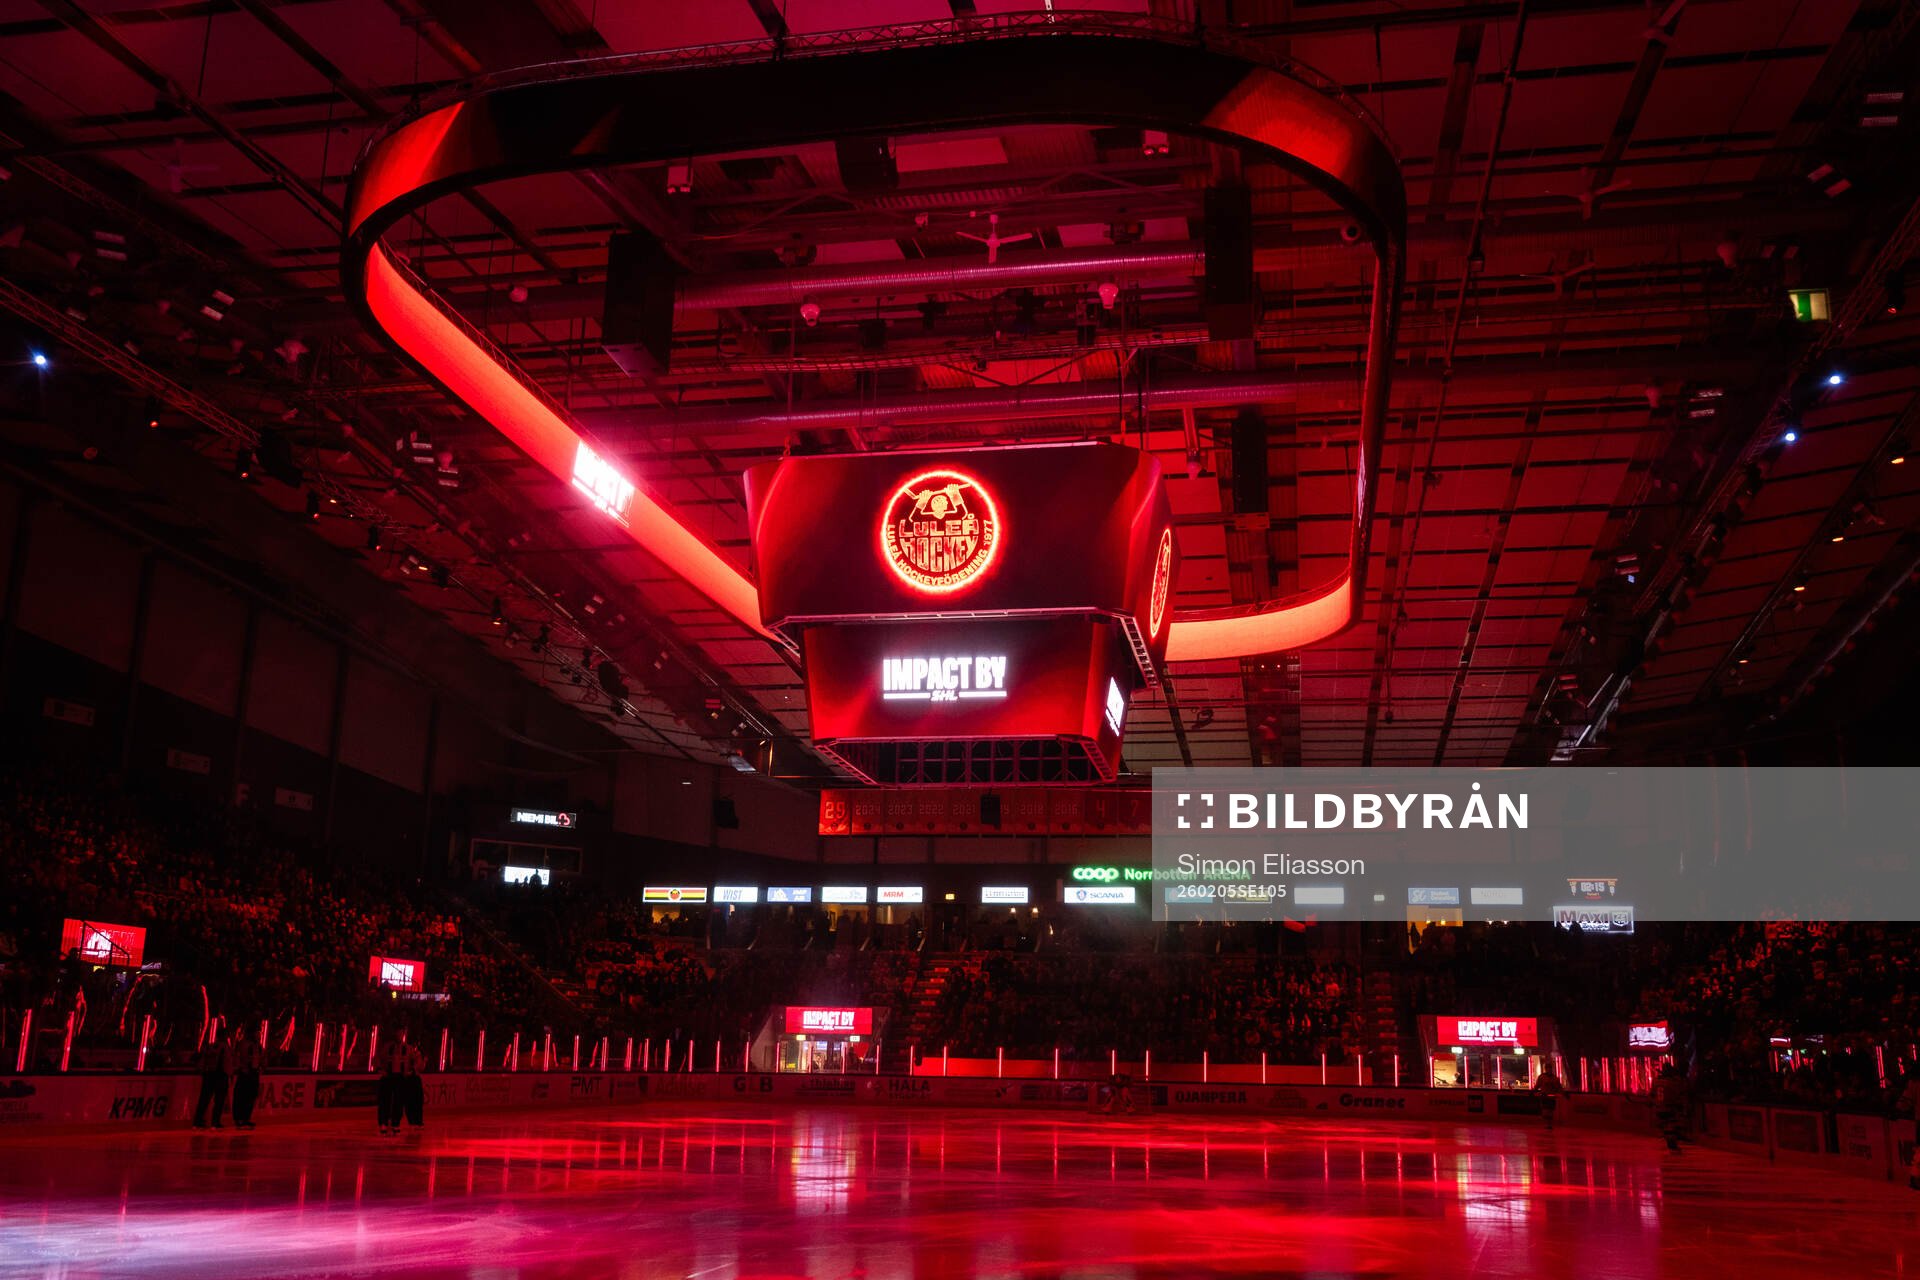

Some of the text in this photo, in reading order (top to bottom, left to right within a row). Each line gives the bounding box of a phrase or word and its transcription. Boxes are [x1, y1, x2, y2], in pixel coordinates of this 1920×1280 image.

[899, 513, 980, 537] LULEÅ
[896, 548, 989, 586] HOCKEYFÖRENING
[983, 519, 993, 546] 1977
[899, 535, 979, 573] HOCKEY
[883, 656, 1006, 690] IMPACT BY
[1073, 867, 1251, 883] coop Norrbotten ARENA
[1559, 910, 1610, 924] MAXI
[803, 1010, 841, 1026] IMPACT
[1458, 1020, 1517, 1037] IMPACT BY
[109, 1096, 168, 1119] KPMG
